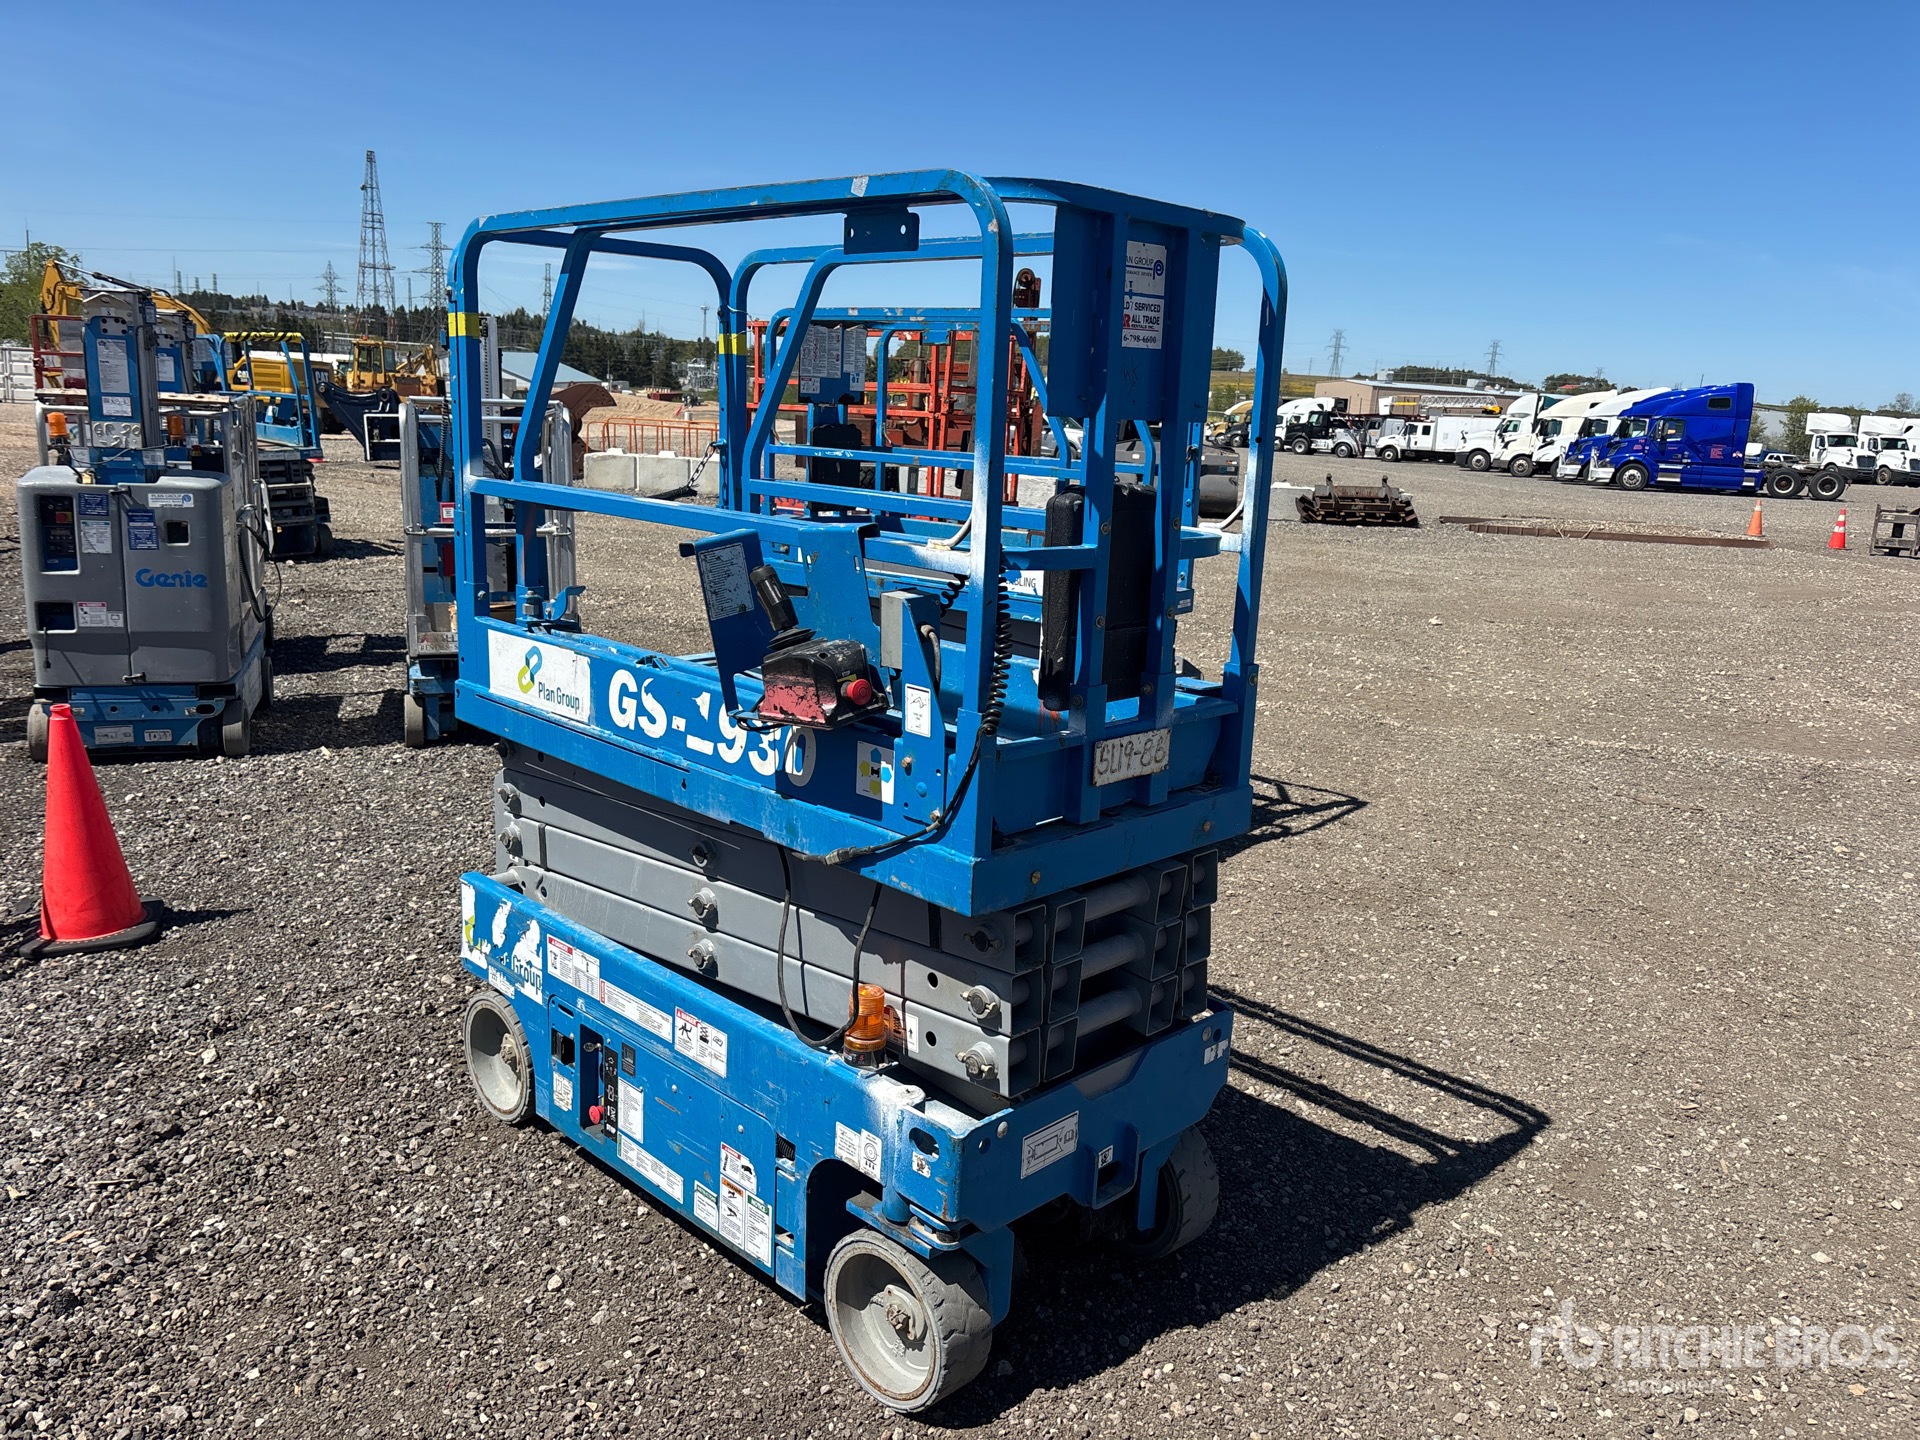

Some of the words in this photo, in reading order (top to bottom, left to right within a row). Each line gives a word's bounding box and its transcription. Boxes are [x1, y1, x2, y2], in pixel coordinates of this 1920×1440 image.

[1134, 302, 1161, 313] SERVICED
[1131, 314, 1141, 324] ALL
[1142, 315, 1160, 326] TRADE
[315, 371, 329, 384] CAT
[135, 568, 208, 588] Genie
[538, 681, 556, 702] Plan
[556, 686, 580, 714] Group
